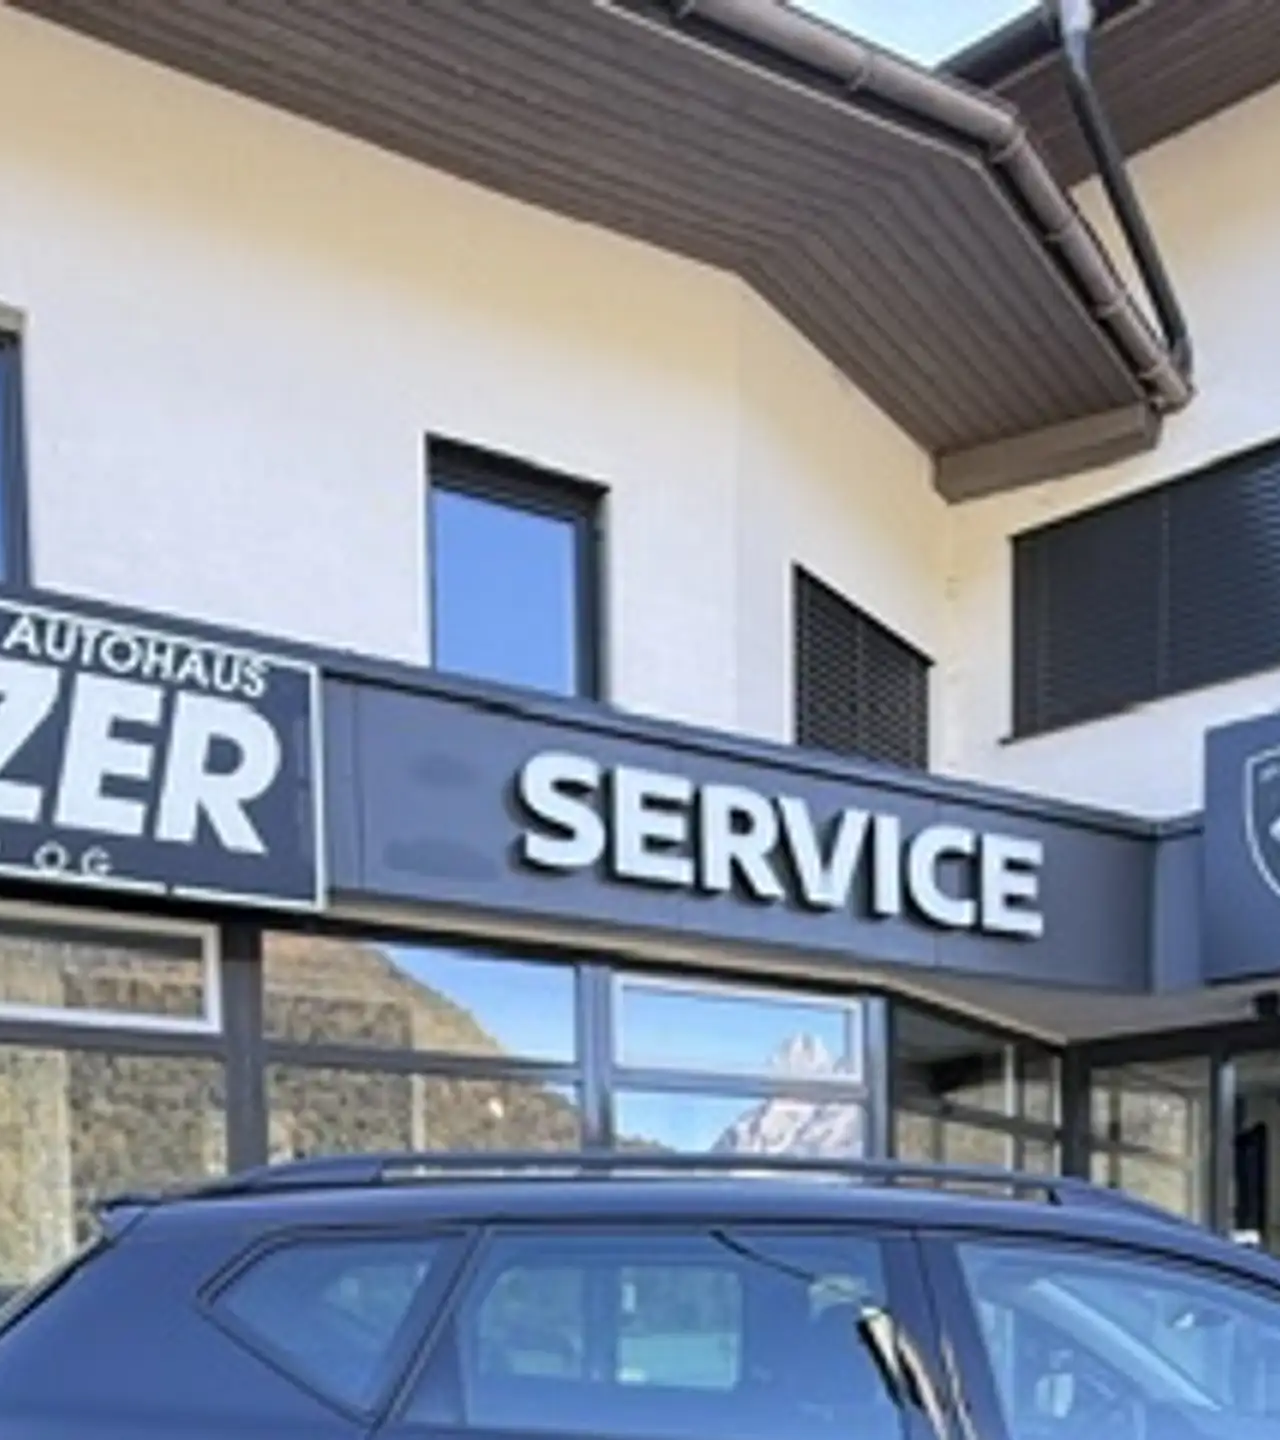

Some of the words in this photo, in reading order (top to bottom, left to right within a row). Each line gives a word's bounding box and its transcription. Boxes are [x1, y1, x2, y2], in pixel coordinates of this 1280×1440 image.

[2, 614, 269, 687] AUTOHAUS
[33, 840, 114, 877] OG
[520, 750, 1044, 935] SERVICE
